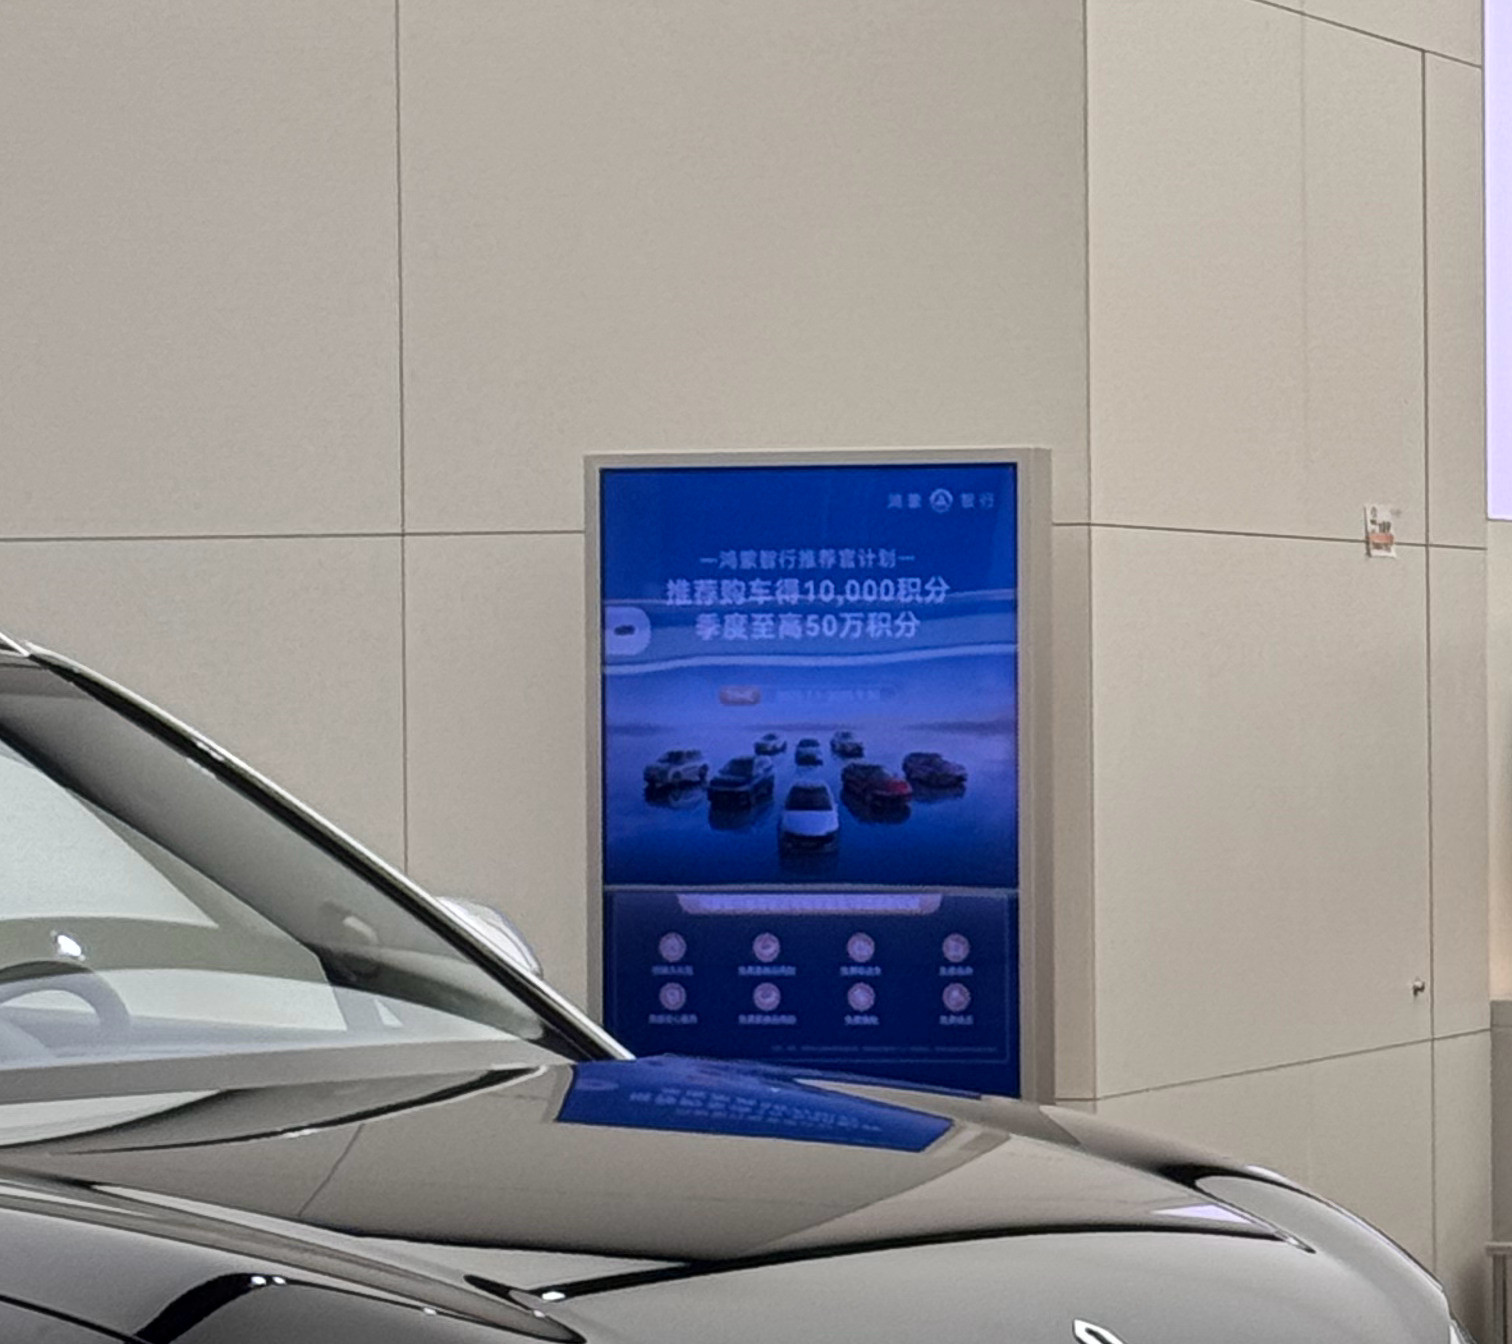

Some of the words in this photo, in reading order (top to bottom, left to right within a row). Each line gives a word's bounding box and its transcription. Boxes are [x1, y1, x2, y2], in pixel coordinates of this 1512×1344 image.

[665, 577, 950, 606] 推荐购车得10,000积分
[696, 611, 921, 640] 季度至高50万积分
